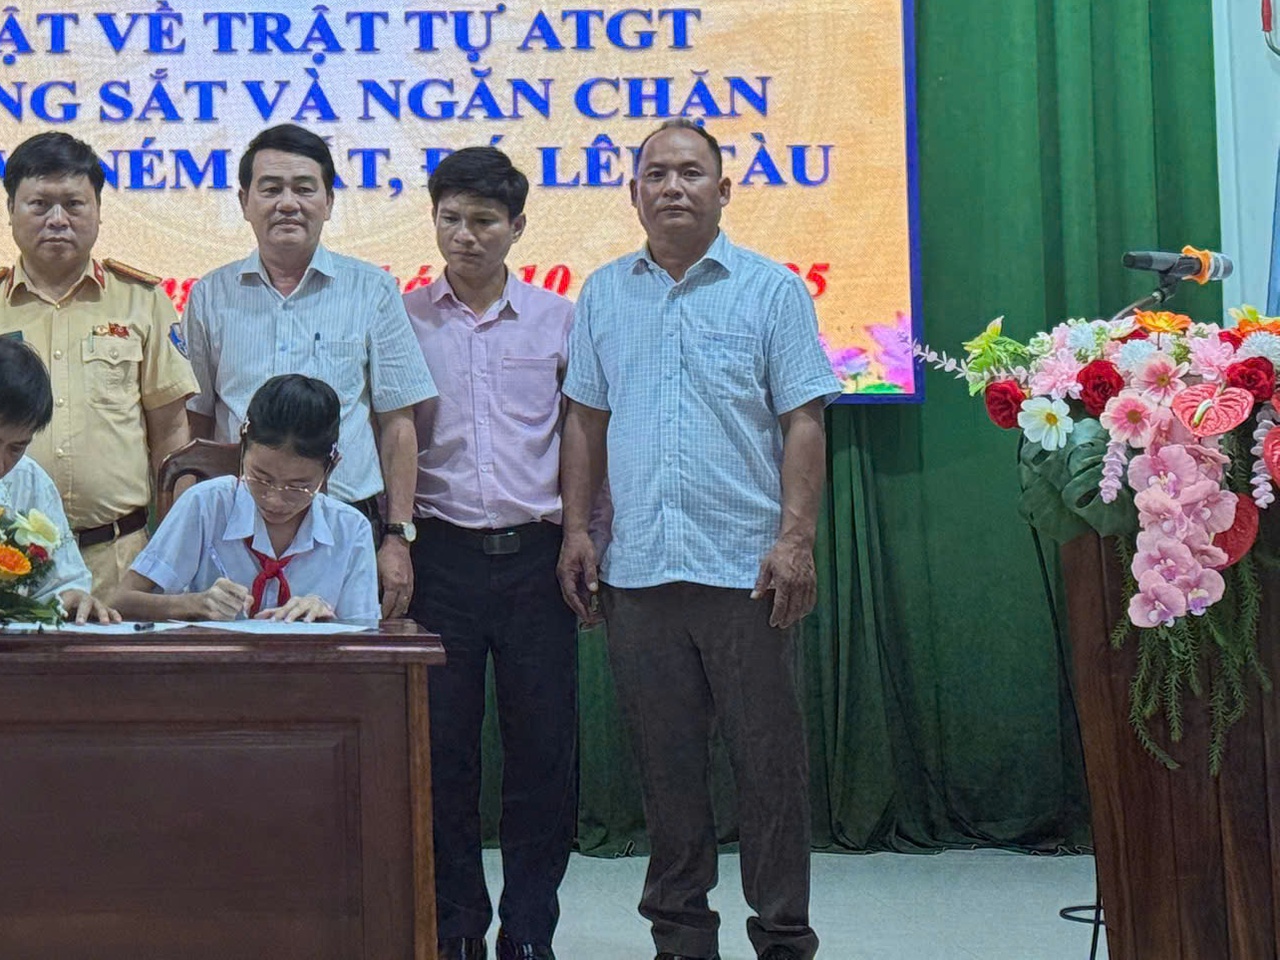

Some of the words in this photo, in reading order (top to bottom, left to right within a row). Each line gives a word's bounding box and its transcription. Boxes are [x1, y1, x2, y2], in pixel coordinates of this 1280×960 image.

[95, 0, 186, 55] VỀ
[203, 4, 389, 66] TRẬT
[404, 3, 507, 63] TỰ
[521, 8, 701, 52] ATGT
[99, 68, 228, 123] SẮT
[241, 67, 340, 122] VÀ
[357, 67, 552, 121] NGĂN
[574, 68, 772, 127] CHẶN
[719, 132, 835, 188] ÀU
